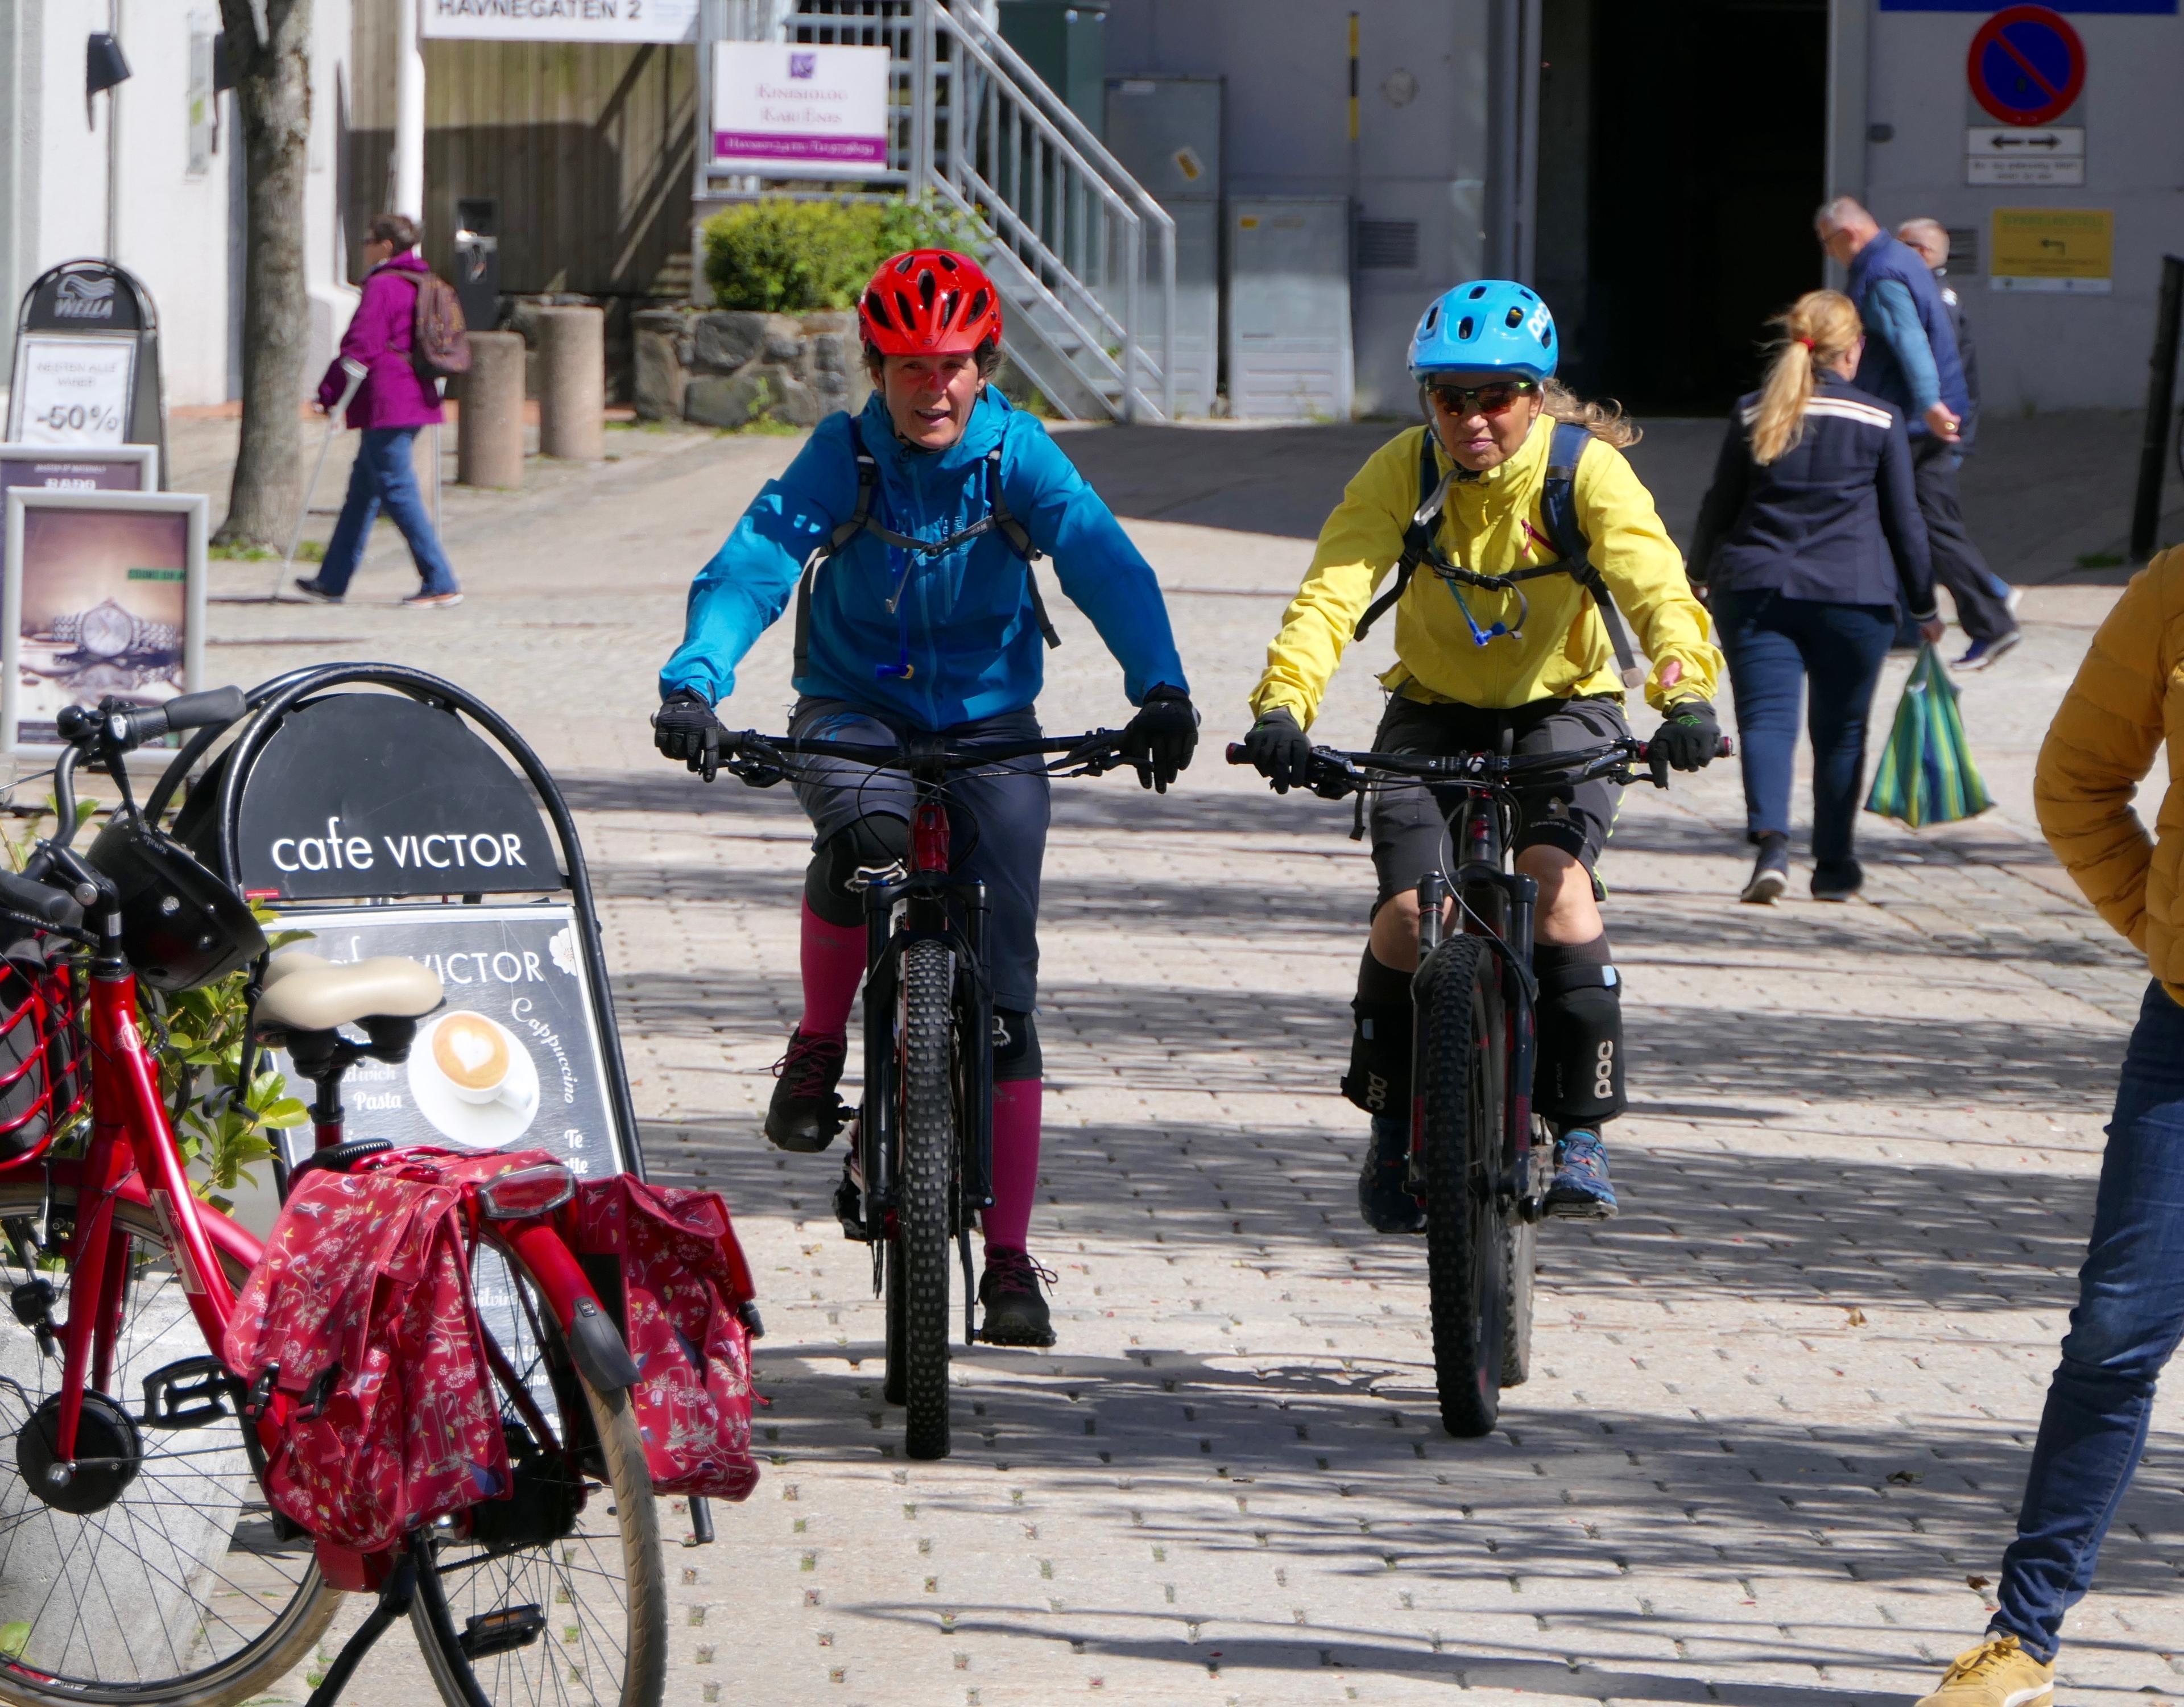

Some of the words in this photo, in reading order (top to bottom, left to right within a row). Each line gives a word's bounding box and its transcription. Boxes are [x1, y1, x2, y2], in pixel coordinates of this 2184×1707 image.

[437, 0, 617, 18] HAVNEGATEN
[628, 0, 642, 20] 2
[54, 299, 113, 319] WELLA
[271, 817, 373, 871] cafe
[384, 834, 526, 869] VICTOR
[511, 998, 578, 1103] Cappuccino
[353, 1092, 403, 1111] Pasta
[564, 1129, 583, 1148] Te
